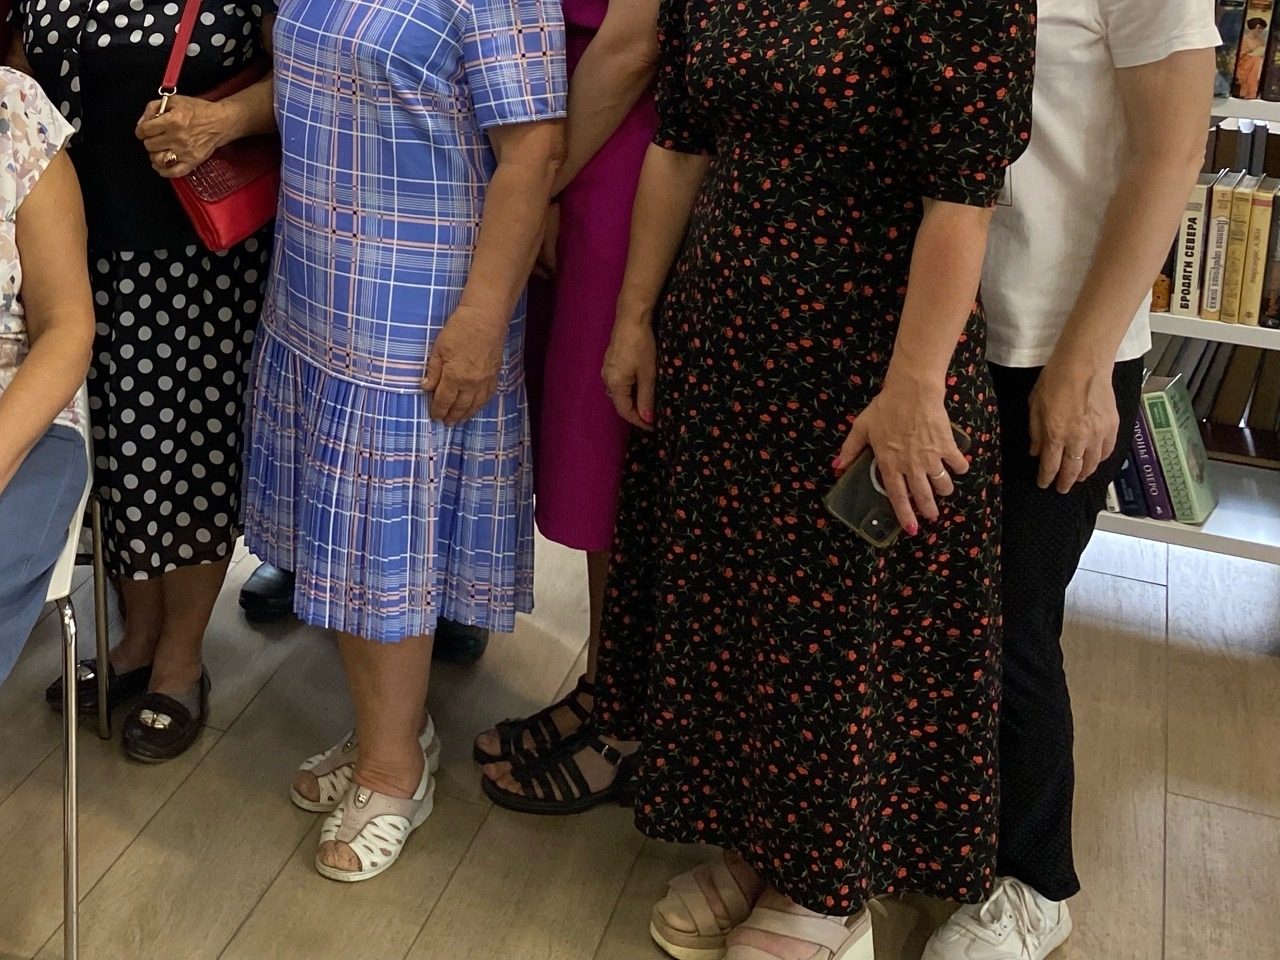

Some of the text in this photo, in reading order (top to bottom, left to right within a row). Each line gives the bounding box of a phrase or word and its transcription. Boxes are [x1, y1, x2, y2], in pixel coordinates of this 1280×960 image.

[1180, 217, 1198, 310] БРОДЯГИ СЕВЕРА
[1133, 421, 1158, 496] ОРОНЬЕ ОЗЕРО
